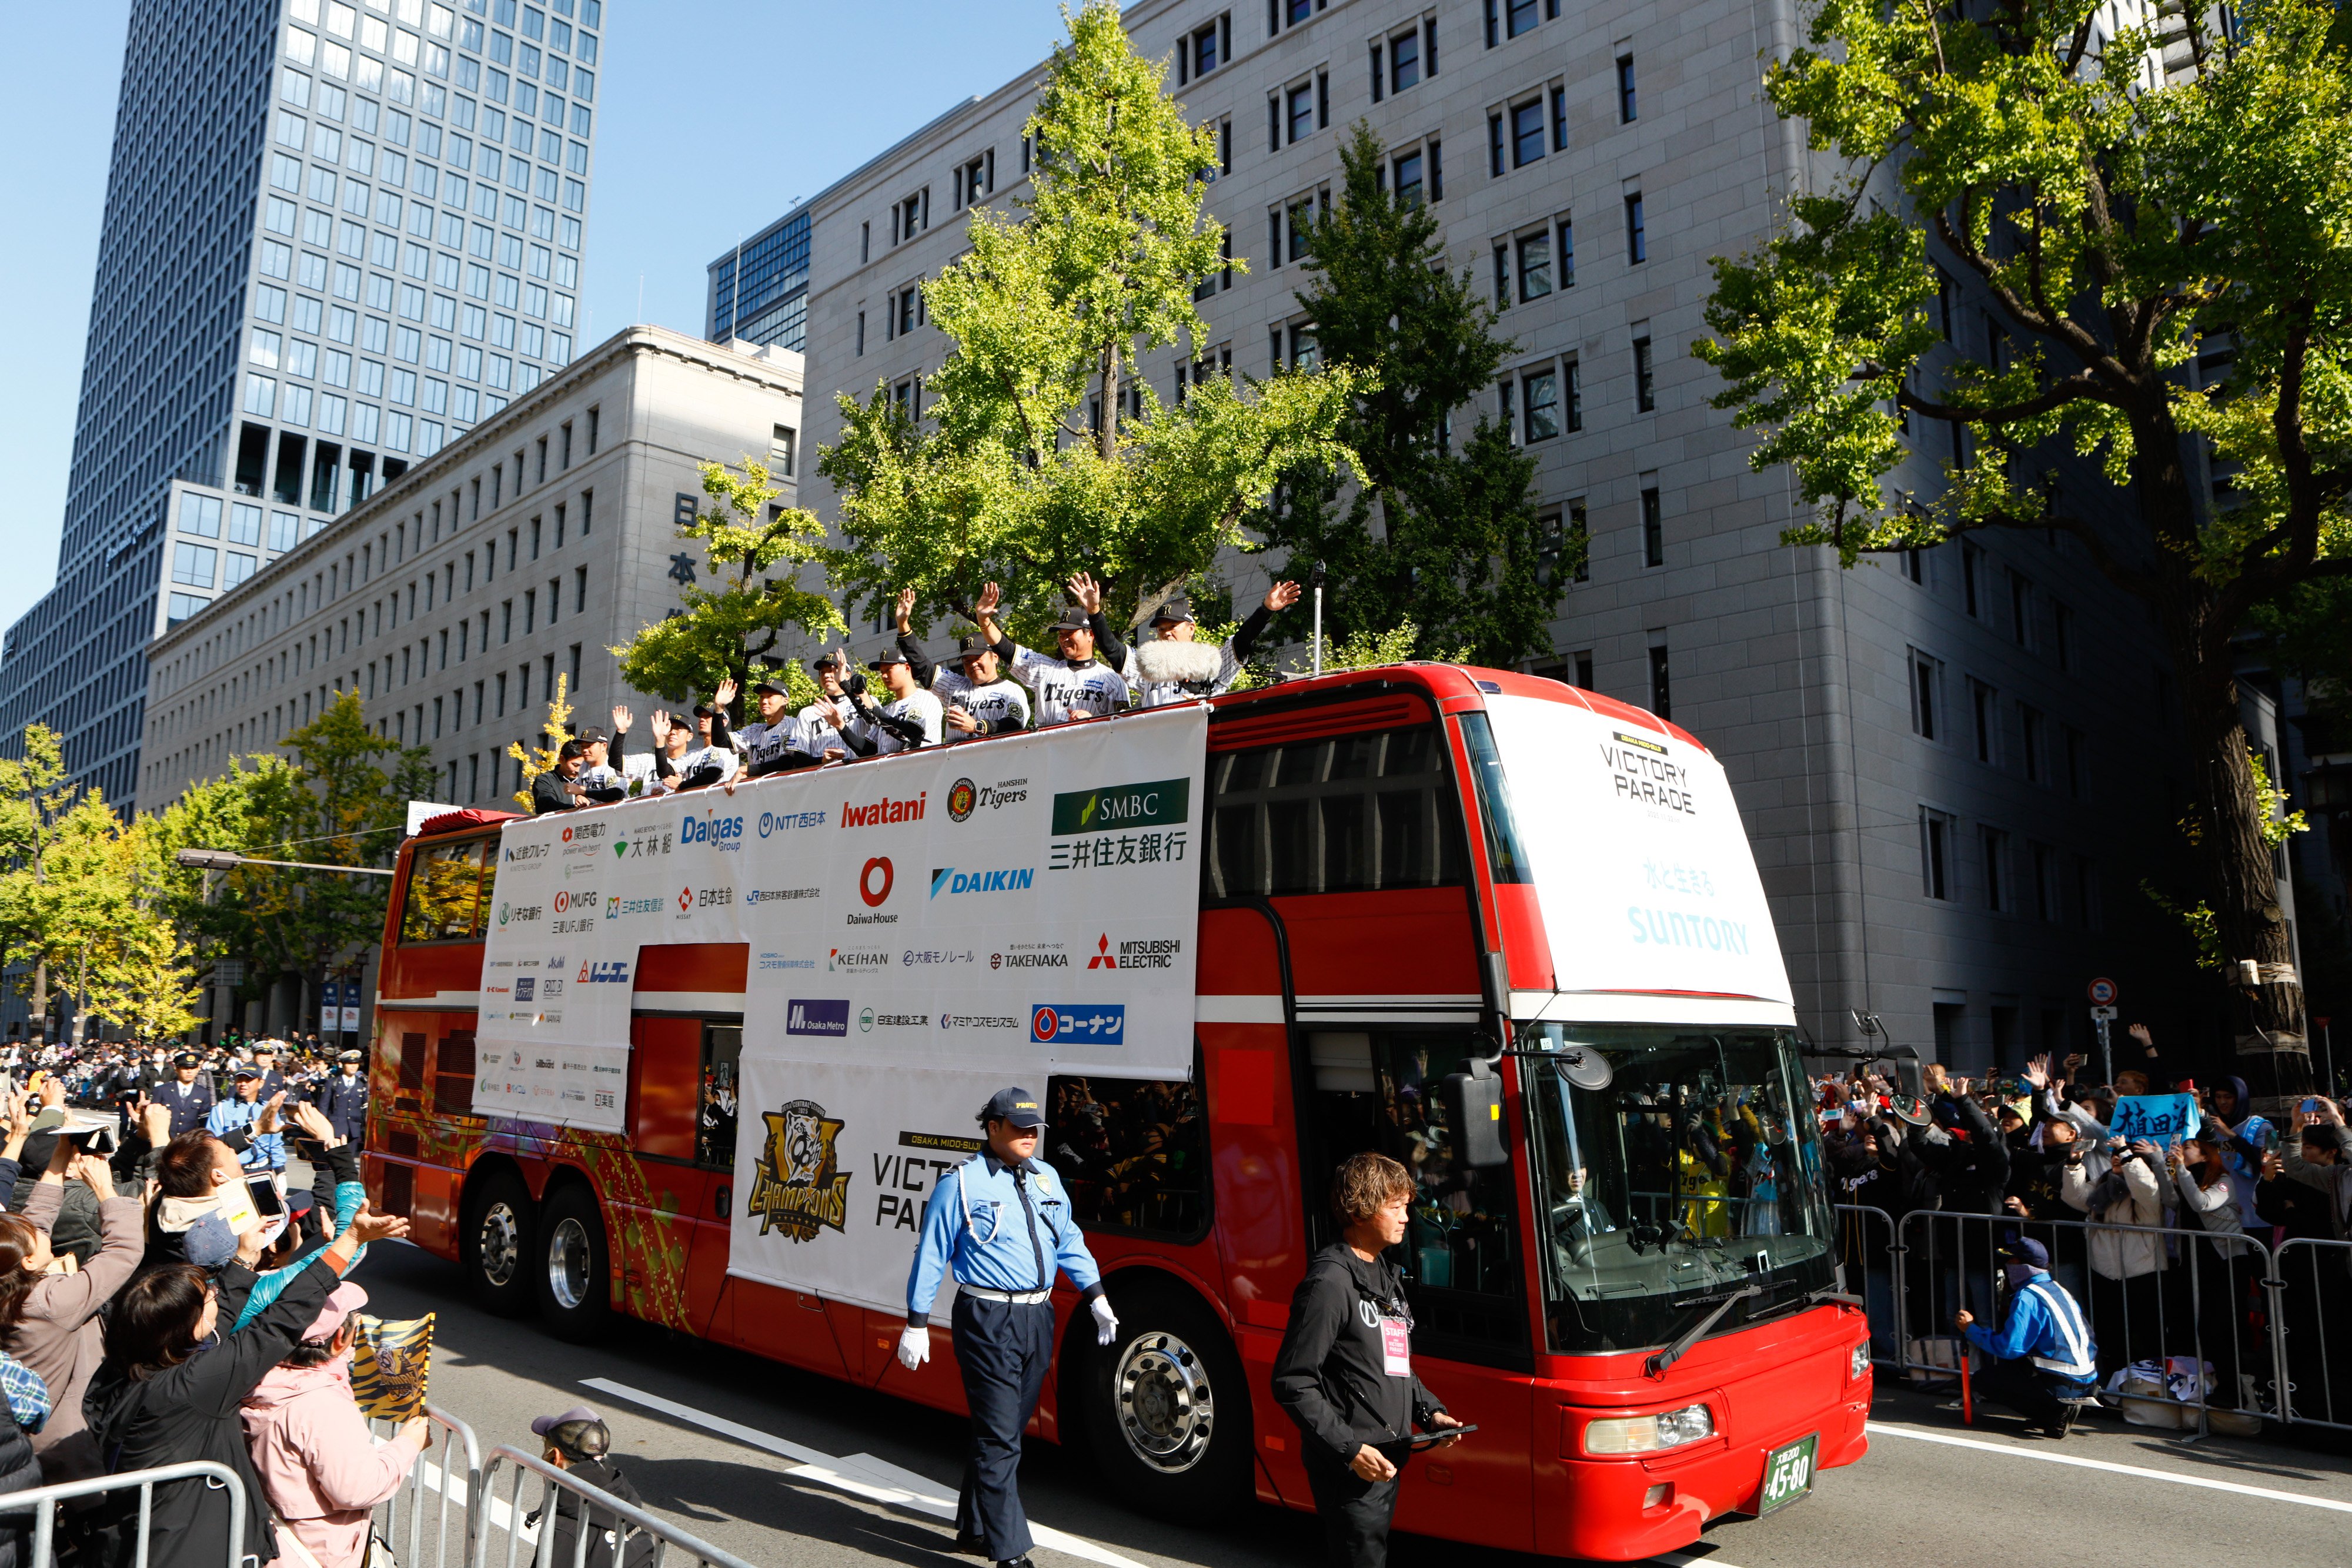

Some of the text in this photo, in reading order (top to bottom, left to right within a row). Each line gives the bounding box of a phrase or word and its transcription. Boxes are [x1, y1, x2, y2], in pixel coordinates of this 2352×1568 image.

[1084, 680, 1104, 689] Joshin
[1045, 683, 1104, 707] Tigers
[965, 696, 1005, 716] igers
[750, 742, 781, 764] Tigers
[1599, 744, 1686, 788] VICTORY
[951, 780, 974, 793] HANSHIN
[997, 778, 1028, 788] HANSHIN
[979, 787, 1027, 809] Tigers
[1613, 774, 1696, 815] PARADE
[841, 791, 927, 828] Iwatani
[1100, 793, 1158, 820] SMBC
[775, 810, 826, 831] NTT西日本
[951, 810, 971, 822] Tigers
[574, 822, 606, 840] 関西電力
[681, 809, 743, 847] Daigas
[516, 843, 551, 860] 近鉄グループ
[563, 844, 601, 857] power with heart
[631, 833, 672, 858] 大林組
[719, 841, 740, 852] Group
[1048, 831, 1187, 870] 三井住友銀行
[950, 868, 1034, 894] DAIKIN
[1643, 857, 1715, 897] 水と生きる
[570, 891, 597, 908] MUFG
[699, 887, 732, 907] 日本生命
[511, 906, 542, 921] りそな銀行
[847, 913, 898, 925] Daiwa House
[552, 919, 594, 934] 三菱UFJ銀行
[1120, 940, 1180, 954] MITSUBISHI
[548, 955, 565, 969] Asahi
[838, 952, 888, 965] KEIHAN
[915, 950, 974, 964] 大阪モノレール
[1004, 954, 1068, 967] TAKENAKA
[1120, 955, 1172, 968] ELECTRIC
[807, 1020, 845, 1031] Osaka Metro
[878, 1015, 928, 1026] 日宝建設工業
[1059, 1015, 1122, 1035] コーナン
[781, 1103, 792, 1112] JERA
[811, 1102, 826, 1117] LEAGUE
[911, 1135, 981, 1151] OSAKA MIDO-SUJI
[874, 1152, 952, 1192] VICT
[749, 1163, 845, 1234] CHAMPIONS
[1385, 1327, 1405, 1338] STAFF
[1769, 1455, 1809, 1500] 45-80
